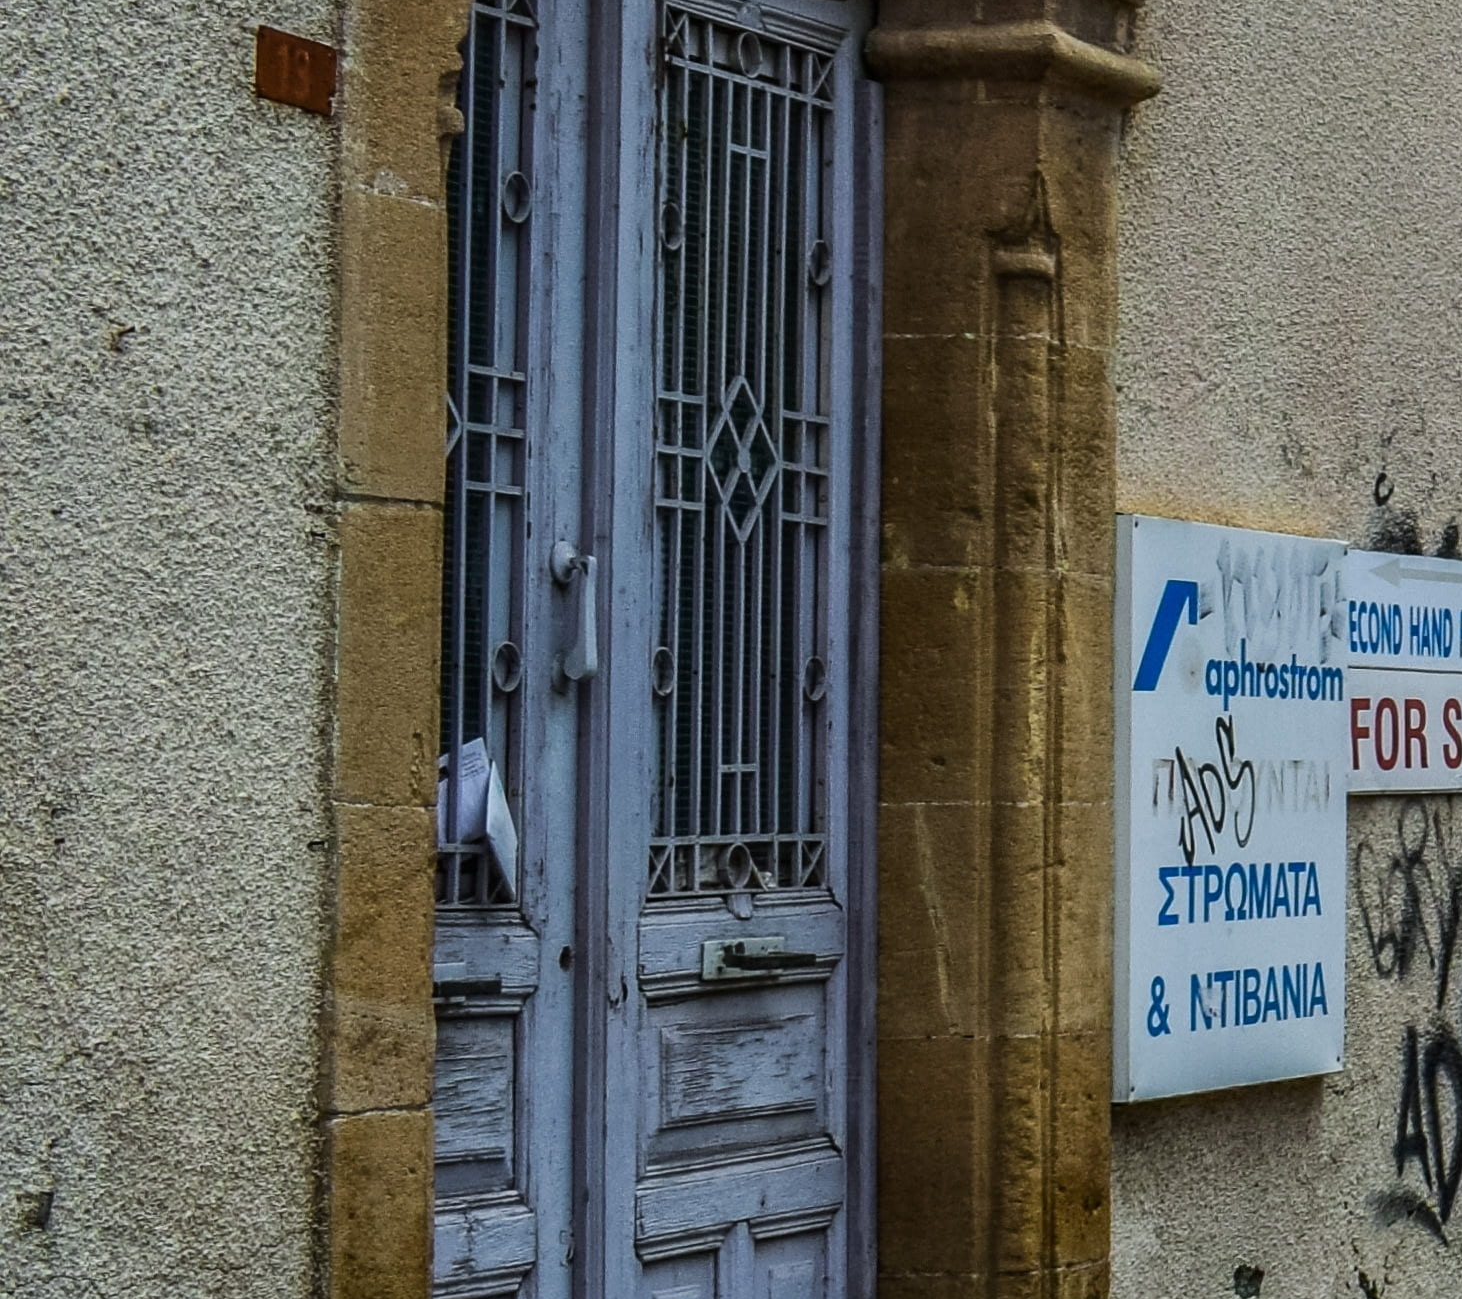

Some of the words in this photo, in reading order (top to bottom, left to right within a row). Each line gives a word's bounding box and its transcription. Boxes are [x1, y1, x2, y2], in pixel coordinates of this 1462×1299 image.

[1349, 599, 1403, 655] ECOND
[1409, 605, 1453, 659] HAND
[1205, 637, 1344, 711] aphrostrom
[1350, 696, 1429, 771] FOR
[1157, 861, 1322, 926] ΣΤΡΩΜΑΤΑ
[1147, 975, 1171, 1038] &
[1190, 962, 1329, 1032] ΝΤΙΒΑΝΙΑ
